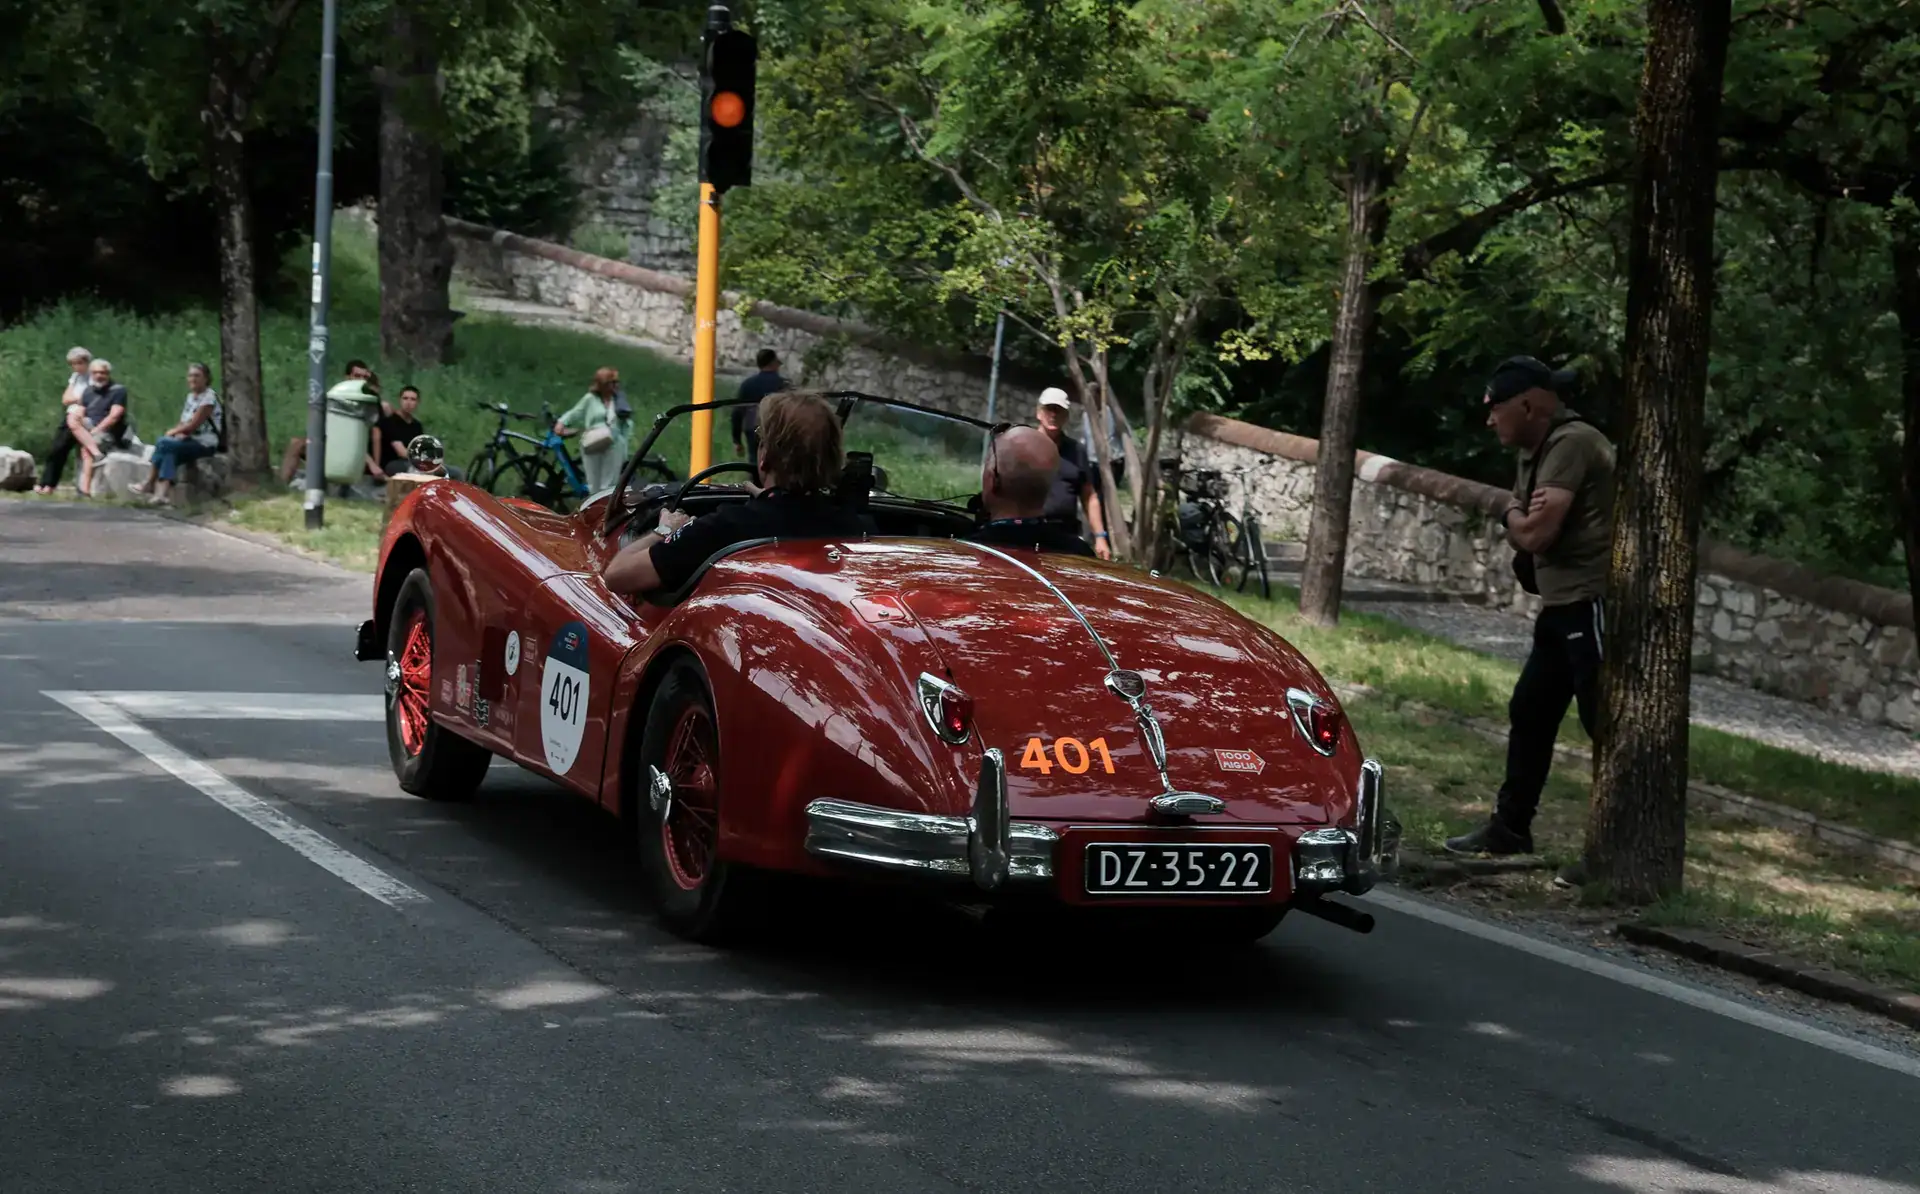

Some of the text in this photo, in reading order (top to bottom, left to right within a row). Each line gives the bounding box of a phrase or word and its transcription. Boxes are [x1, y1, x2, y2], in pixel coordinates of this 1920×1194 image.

[549, 672, 580, 725] 401
[1020, 737, 1115, 774] 401
[1221, 752, 1251, 760] 1000
[1223, 761, 1257, 769] MIGLIA
[1100, 851, 1259, 886] DZ-35-22
